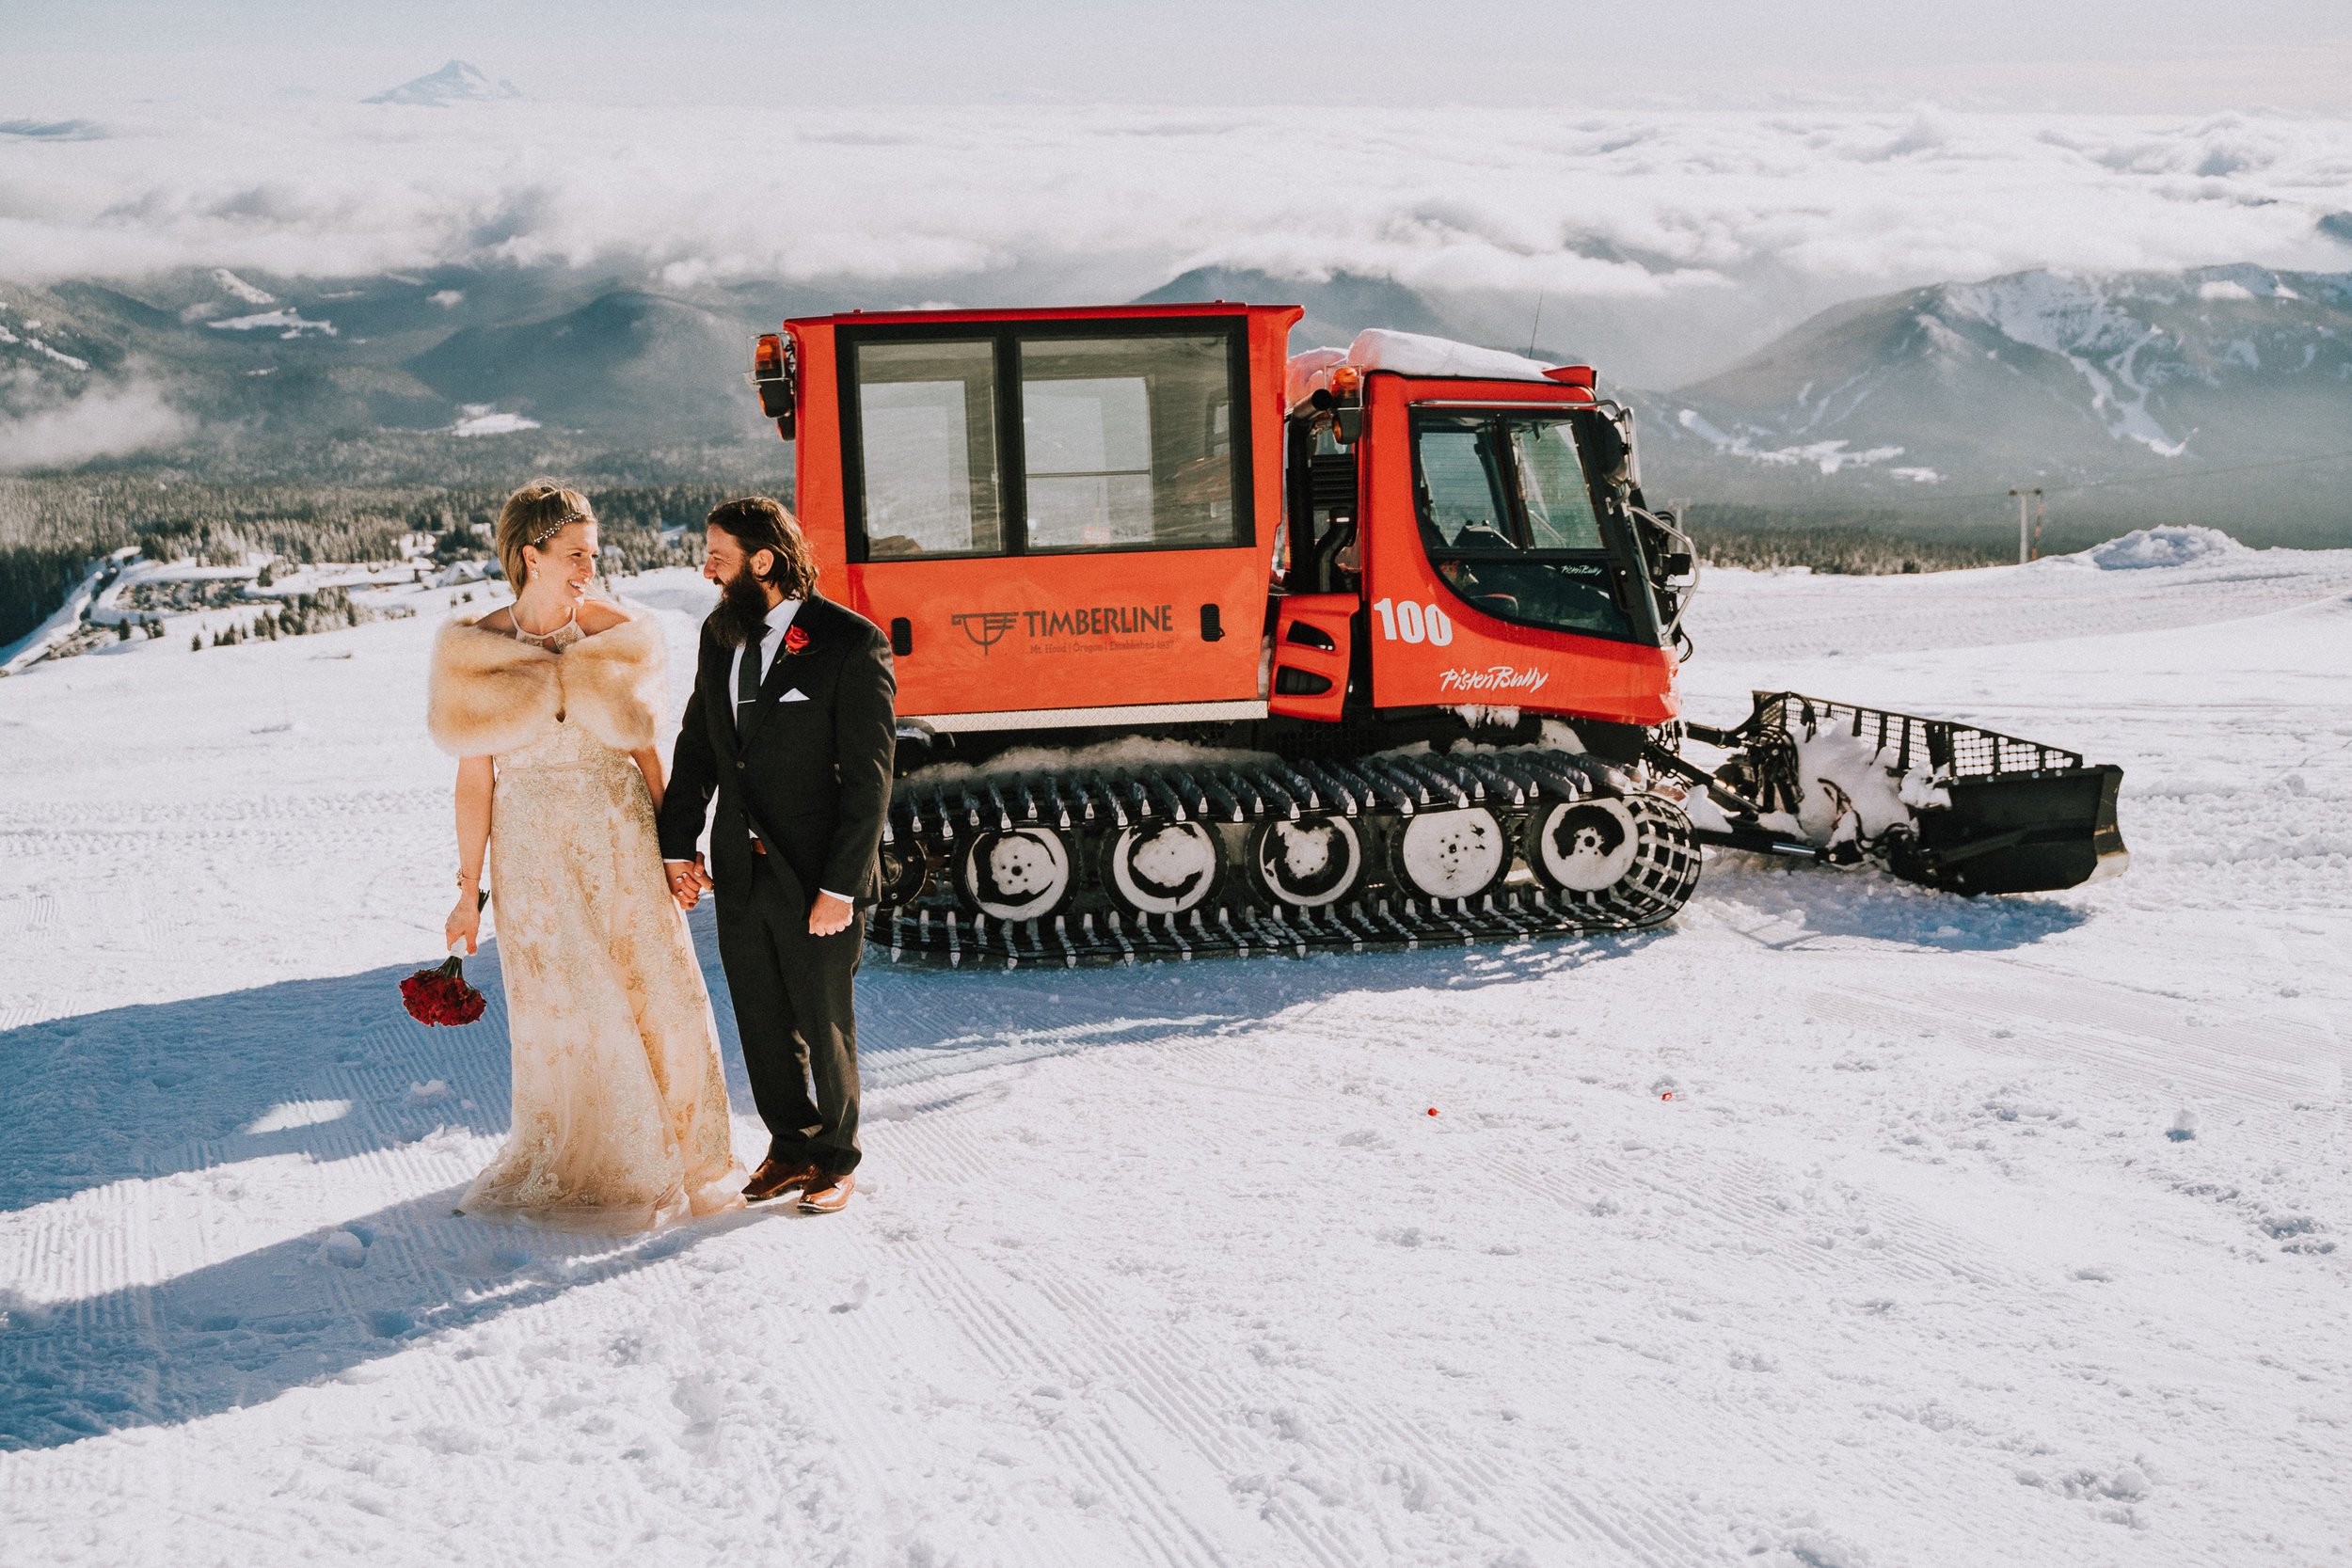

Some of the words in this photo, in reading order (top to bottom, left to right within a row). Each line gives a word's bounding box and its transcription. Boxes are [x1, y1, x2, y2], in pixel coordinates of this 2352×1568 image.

[1023, 605, 1173, 637] TIMBERLINE
[1373, 597, 1453, 646] 100
[1439, 666, 1549, 693] PistenBully
